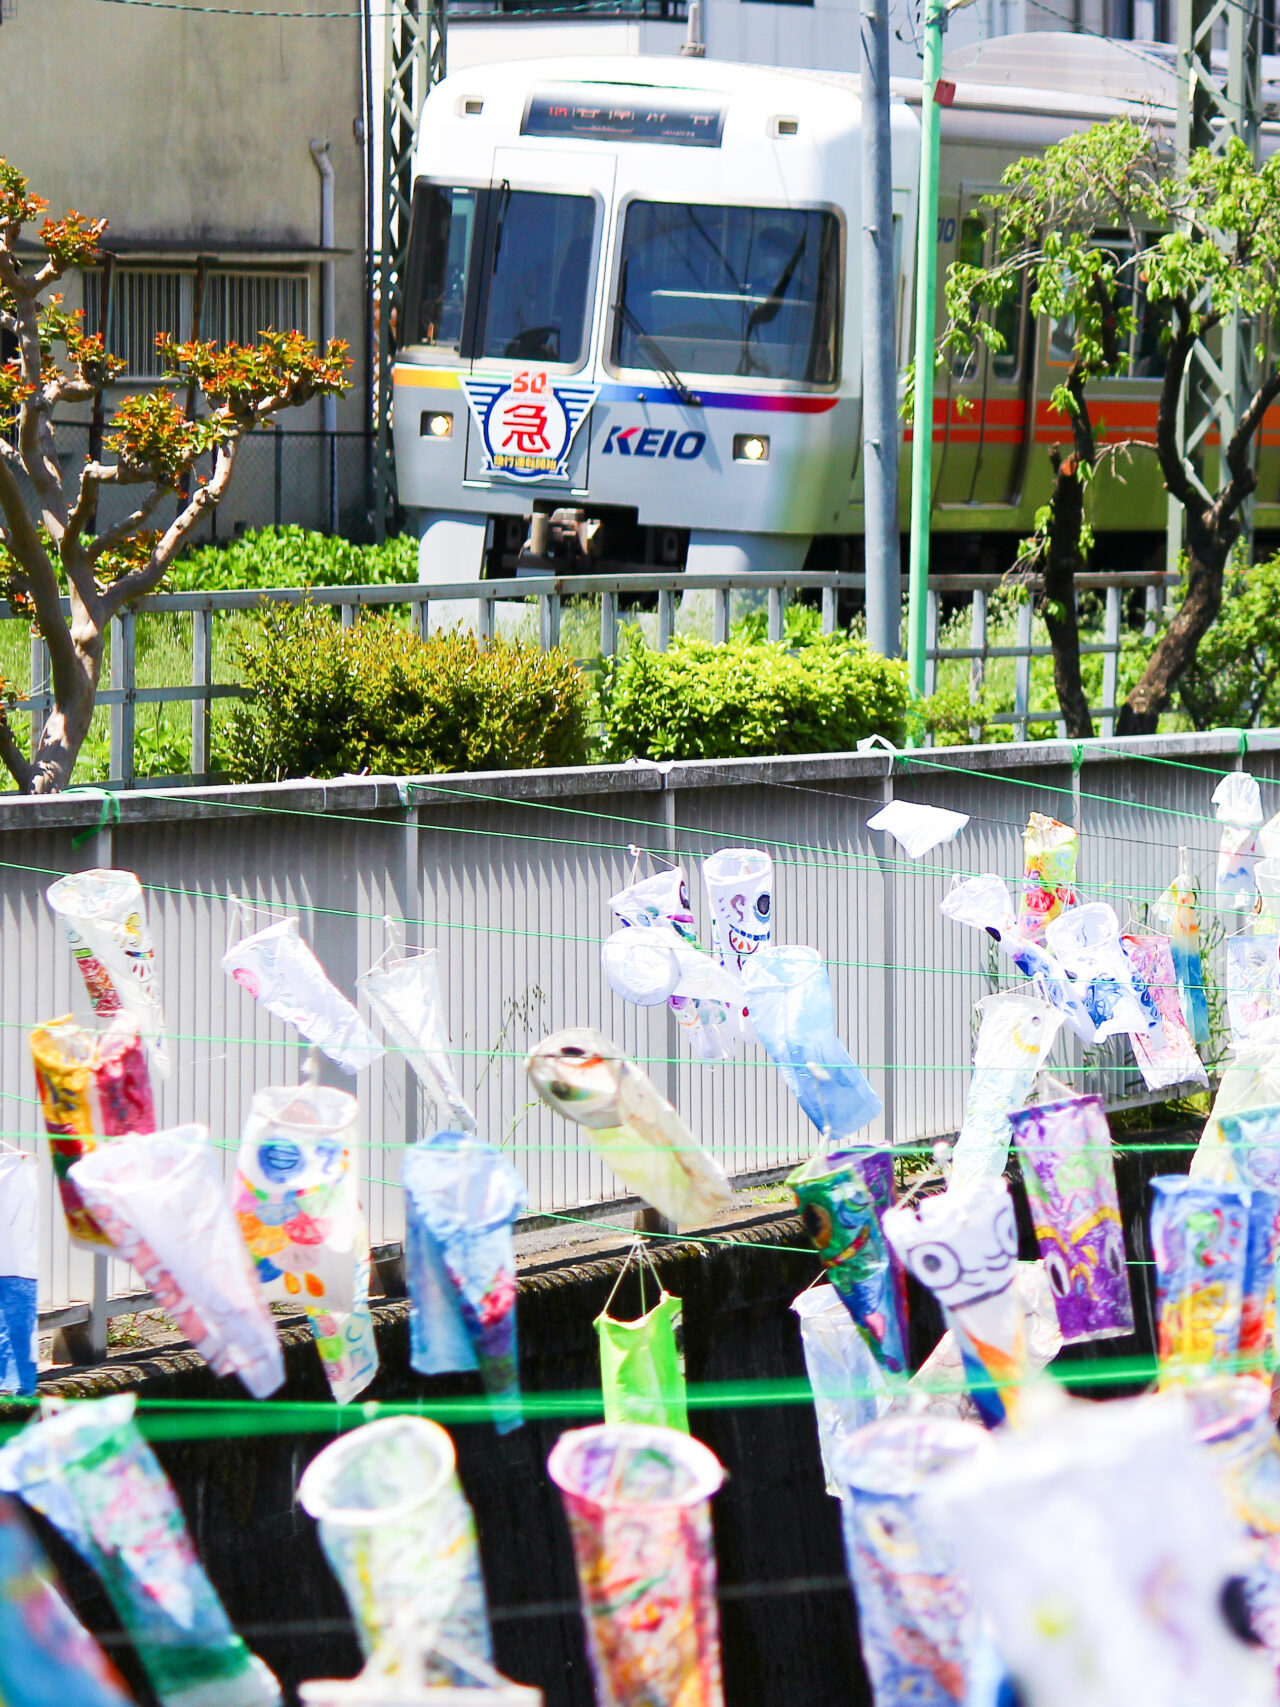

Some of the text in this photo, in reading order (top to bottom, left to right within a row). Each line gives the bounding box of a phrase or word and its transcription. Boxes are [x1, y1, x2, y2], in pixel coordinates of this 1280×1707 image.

[513, 371, 547, 394] 50
[502, 404, 551, 453] 急
[602, 426, 706, 460] KEIO
